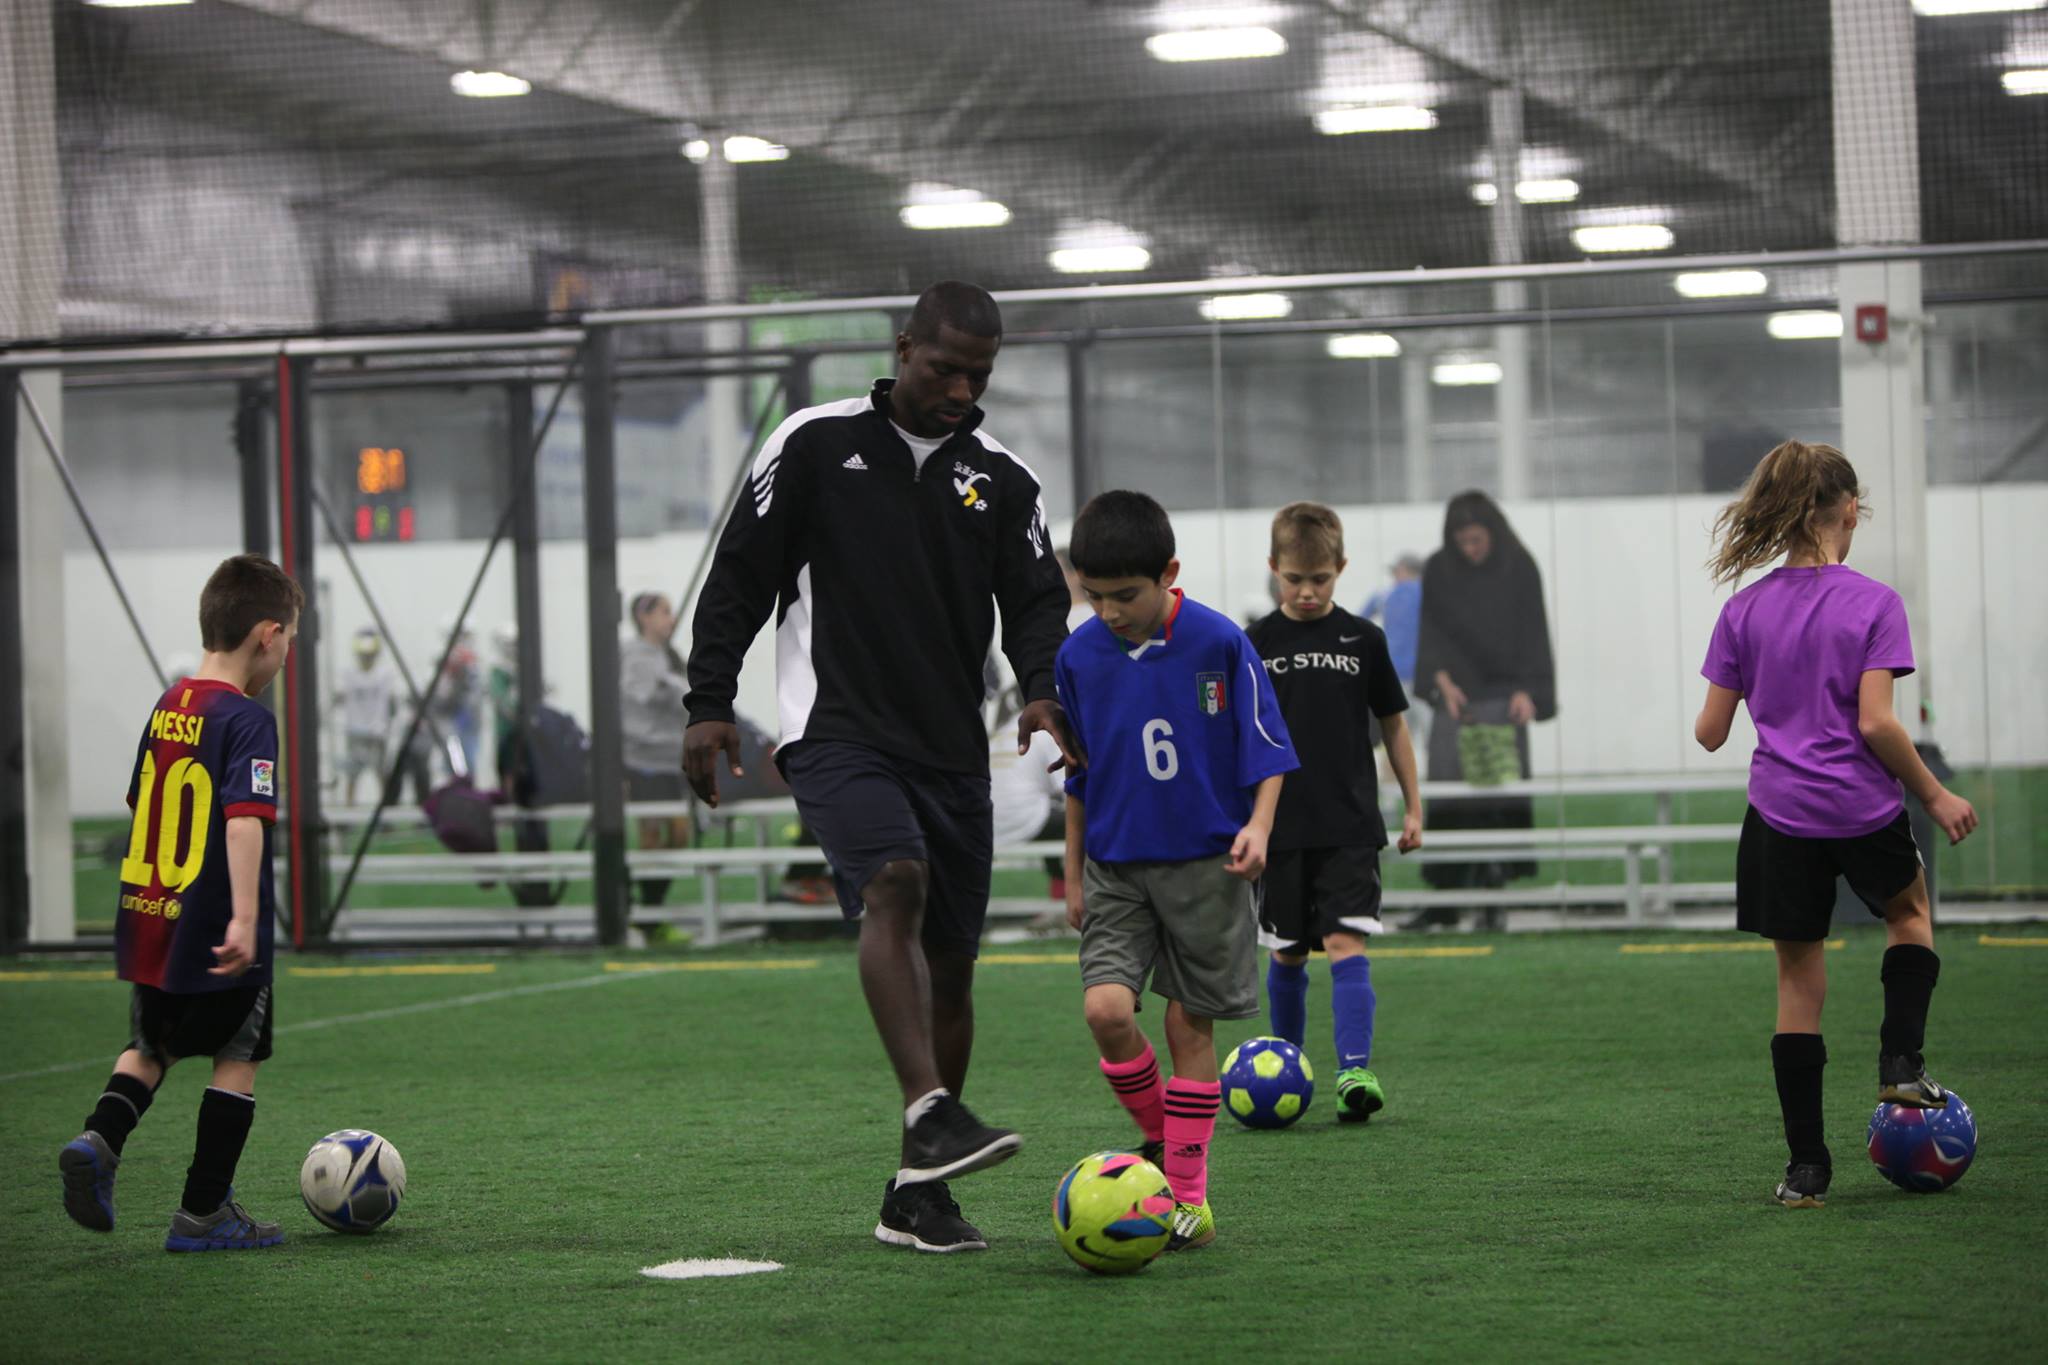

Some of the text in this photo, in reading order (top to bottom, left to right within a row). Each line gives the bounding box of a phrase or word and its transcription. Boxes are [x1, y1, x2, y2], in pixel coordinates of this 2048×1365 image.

[1294, 653, 1360, 675] STARS
[150, 709, 204, 746] MESSI
[1142, 718, 1179, 781] 6
[120, 749, 213, 893] 10
[121, 893, 166, 916] unicef
